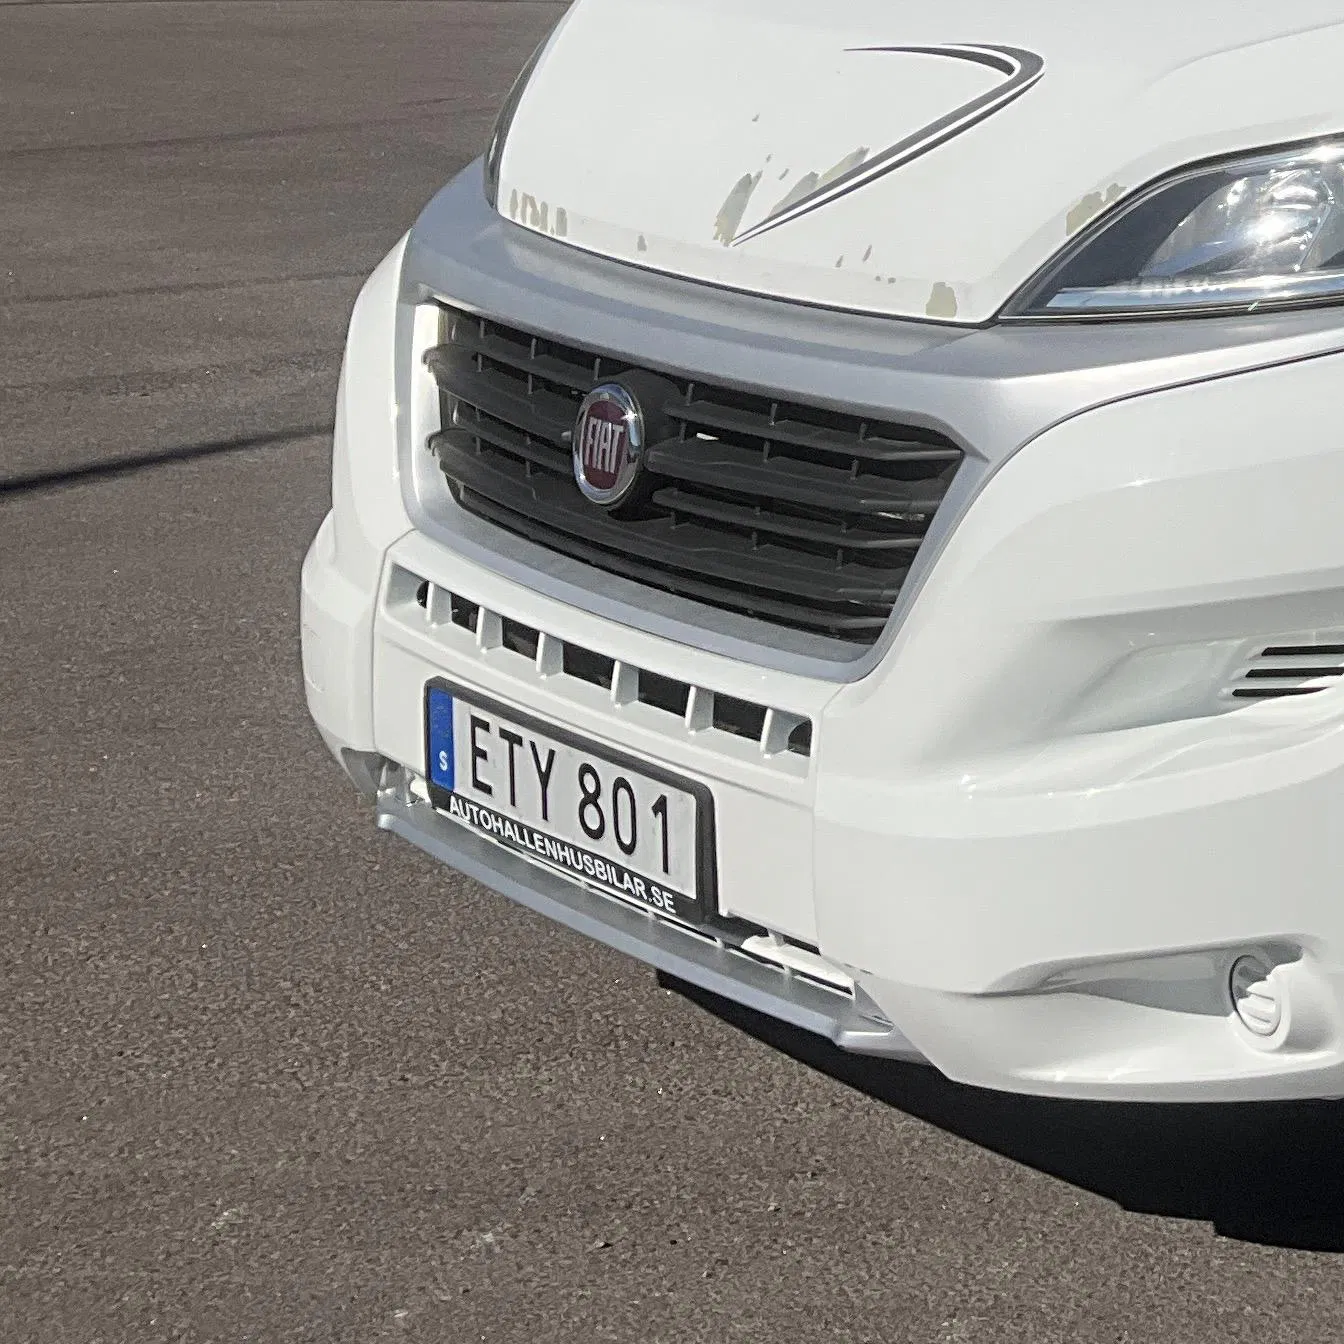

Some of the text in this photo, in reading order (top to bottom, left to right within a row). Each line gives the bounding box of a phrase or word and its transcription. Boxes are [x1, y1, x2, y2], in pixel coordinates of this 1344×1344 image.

[584, 416, 625, 474] FIAT
[438, 713, 670, 876] S ETY 801
[449, 795, 677, 914] AUTOHALLENHUSBILAR.SE
